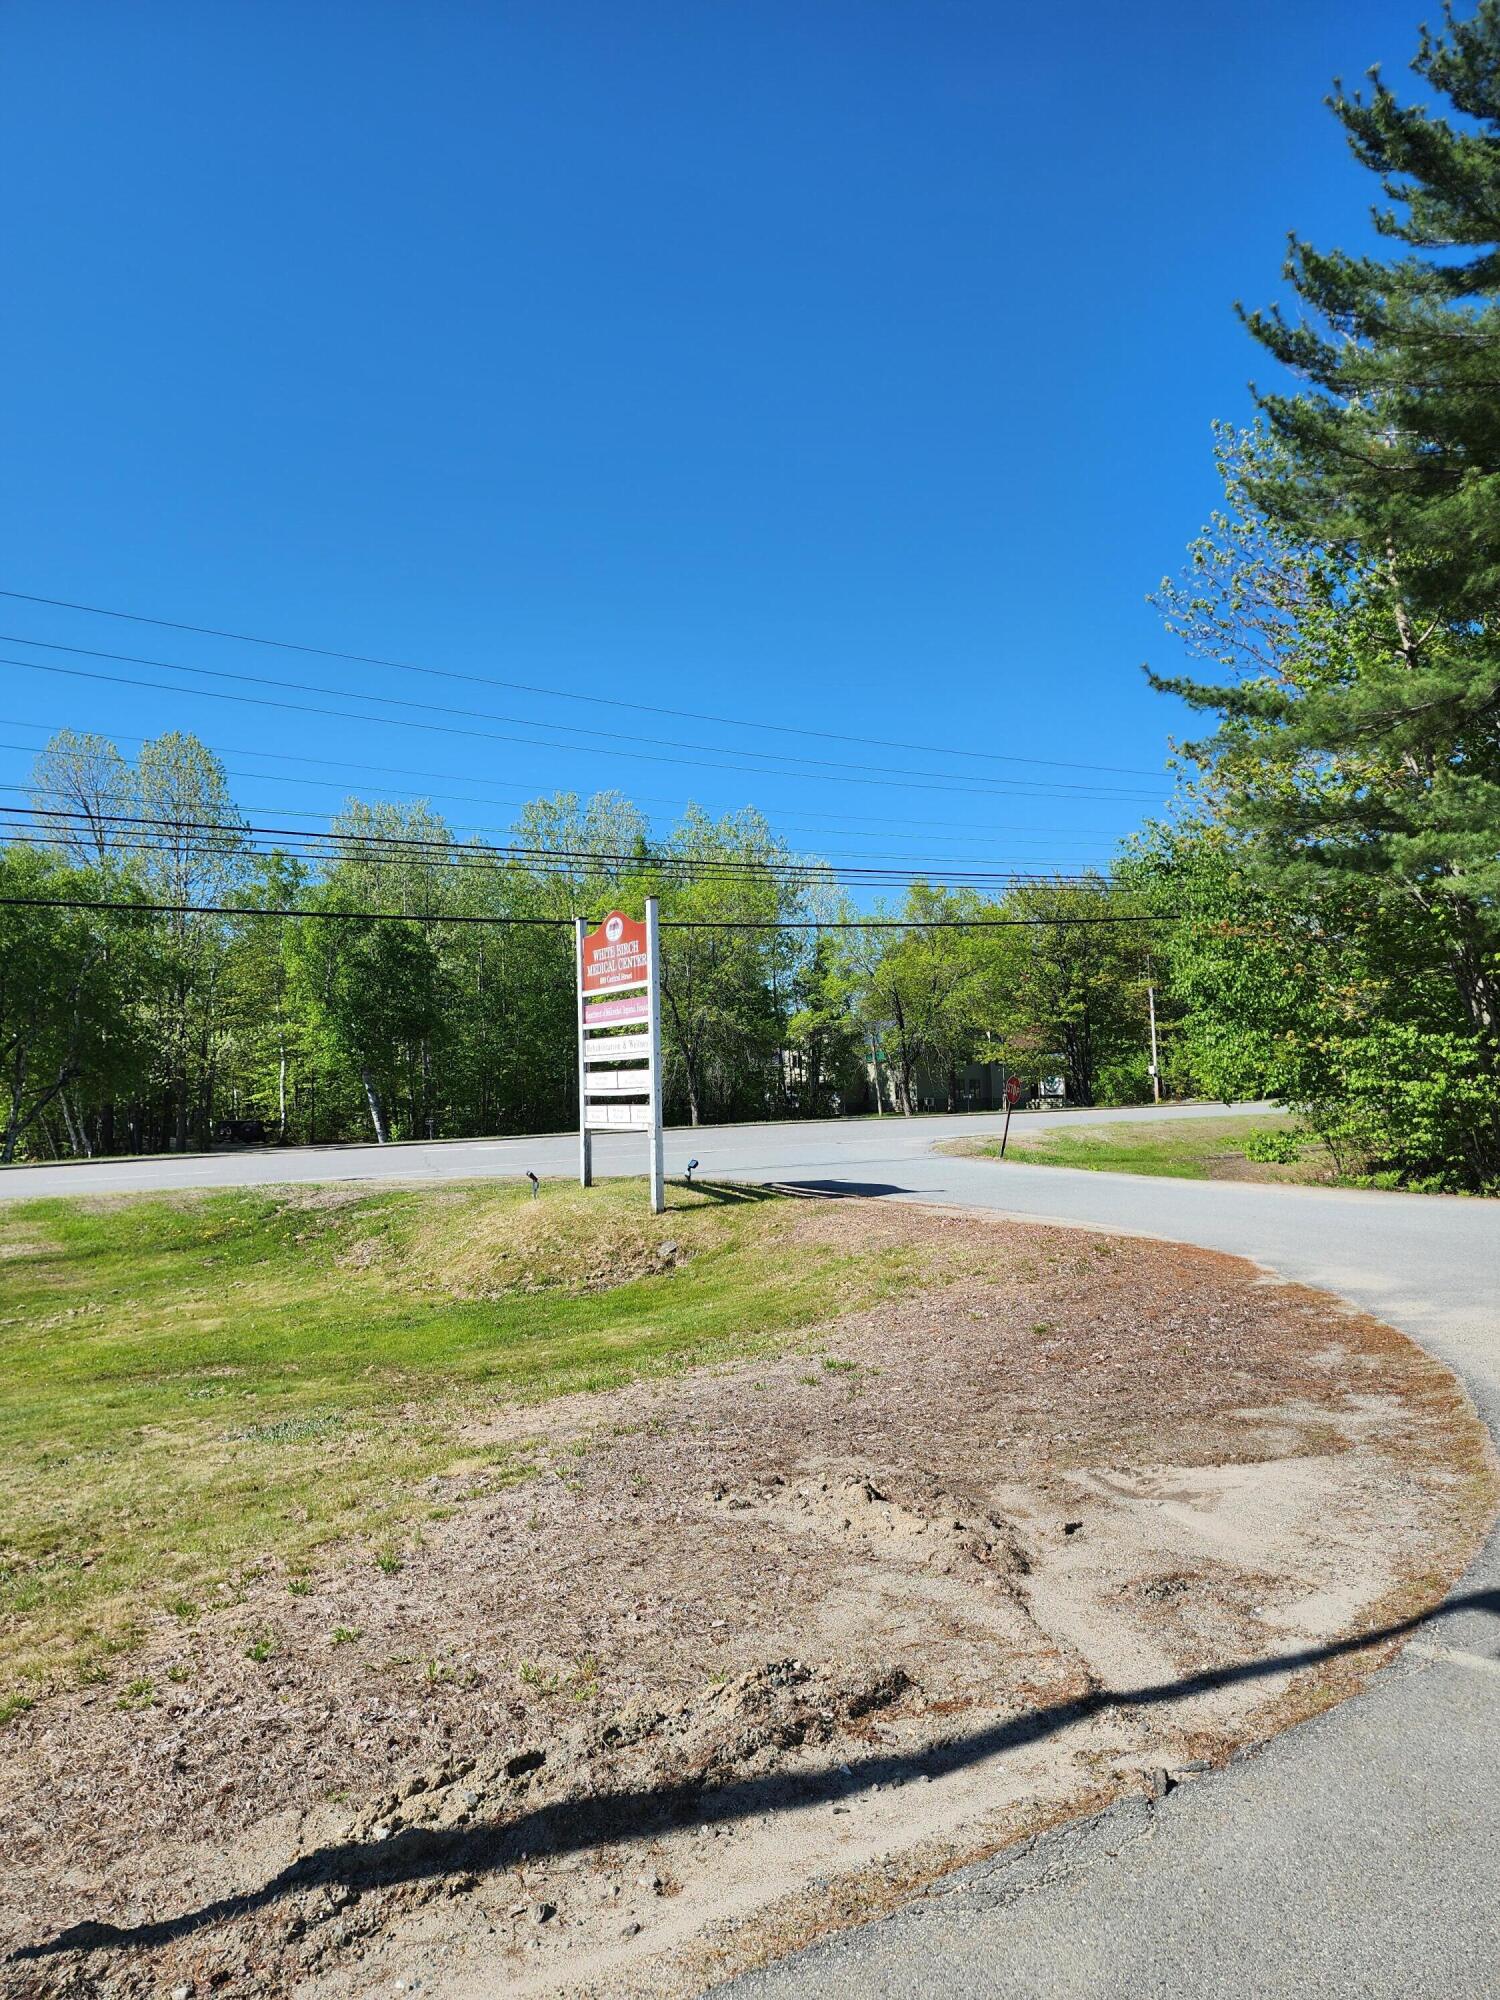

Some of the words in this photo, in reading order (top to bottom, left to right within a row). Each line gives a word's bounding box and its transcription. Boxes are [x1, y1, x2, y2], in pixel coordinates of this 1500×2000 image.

[592, 946, 616, 961] WHITE
[616, 940, 639, 955] BIRCH
[587, 960, 617, 977] MEDICAL
[618, 953, 647, 970] CENTER
[1007, 1083, 1020, 1096] STOP
